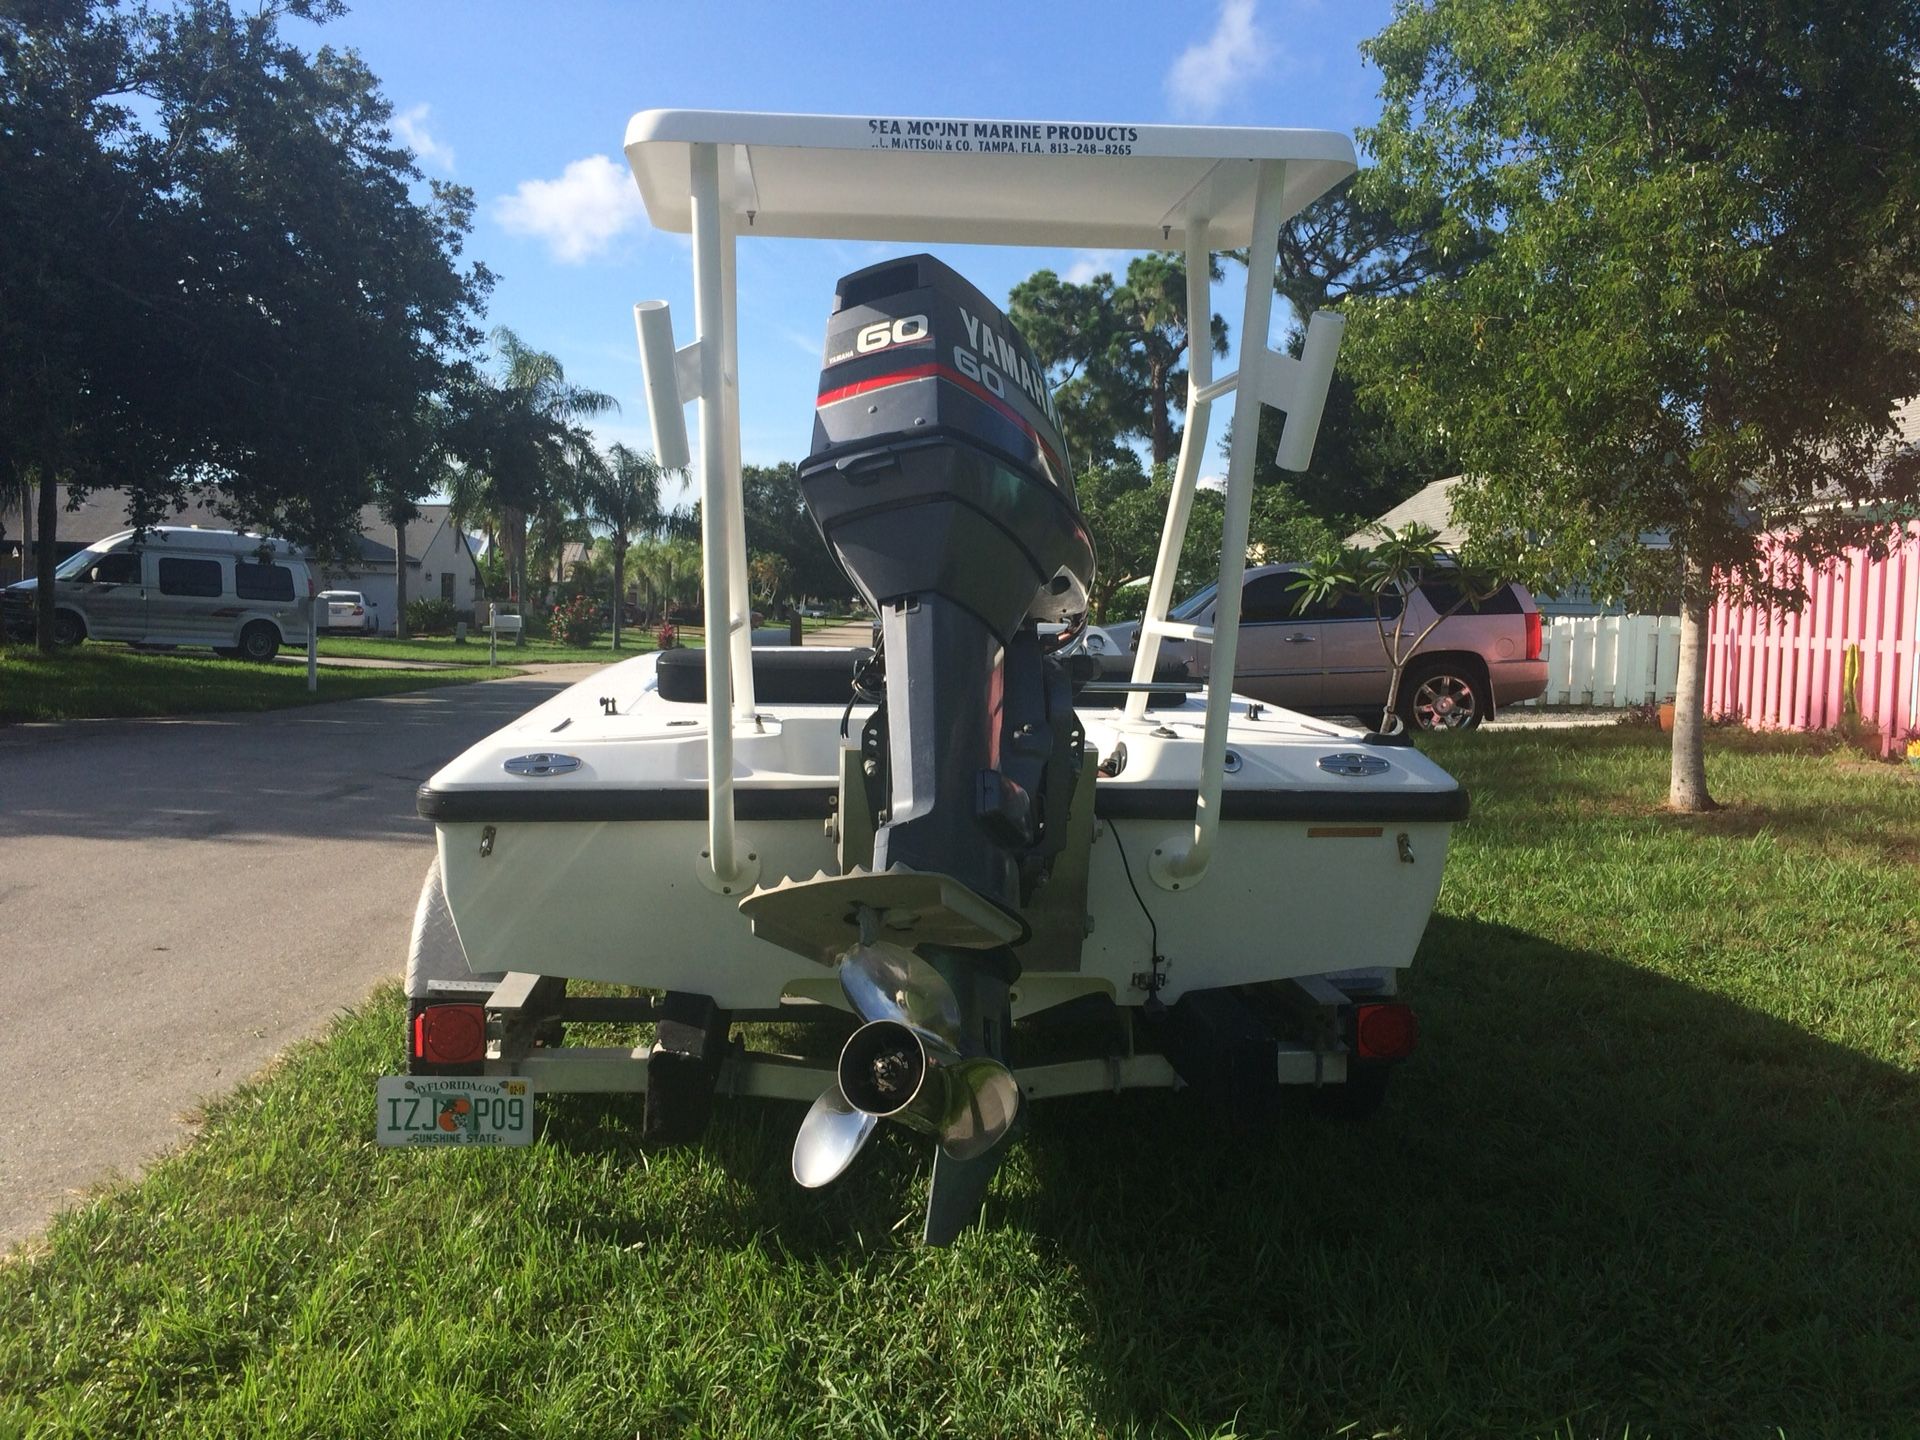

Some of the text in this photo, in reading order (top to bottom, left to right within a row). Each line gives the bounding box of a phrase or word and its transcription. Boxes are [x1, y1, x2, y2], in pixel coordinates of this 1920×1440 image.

[868, 119, 1138, 142] SEA MOUNT MARINE PRODUCTS
[891, 137, 943, 150] MATTSON
[945, 140, 953, 151] &
[1021, 142, 1044, 153] FLA.
[1049, 143, 1132, 156] 813-248-8265
[856, 314, 929, 354] 60
[953, 345, 1005, 399] 60
[387, 1098, 524, 1131] IZJ P09
[413, 1133, 497, 1143] SUNSHINE STATE
